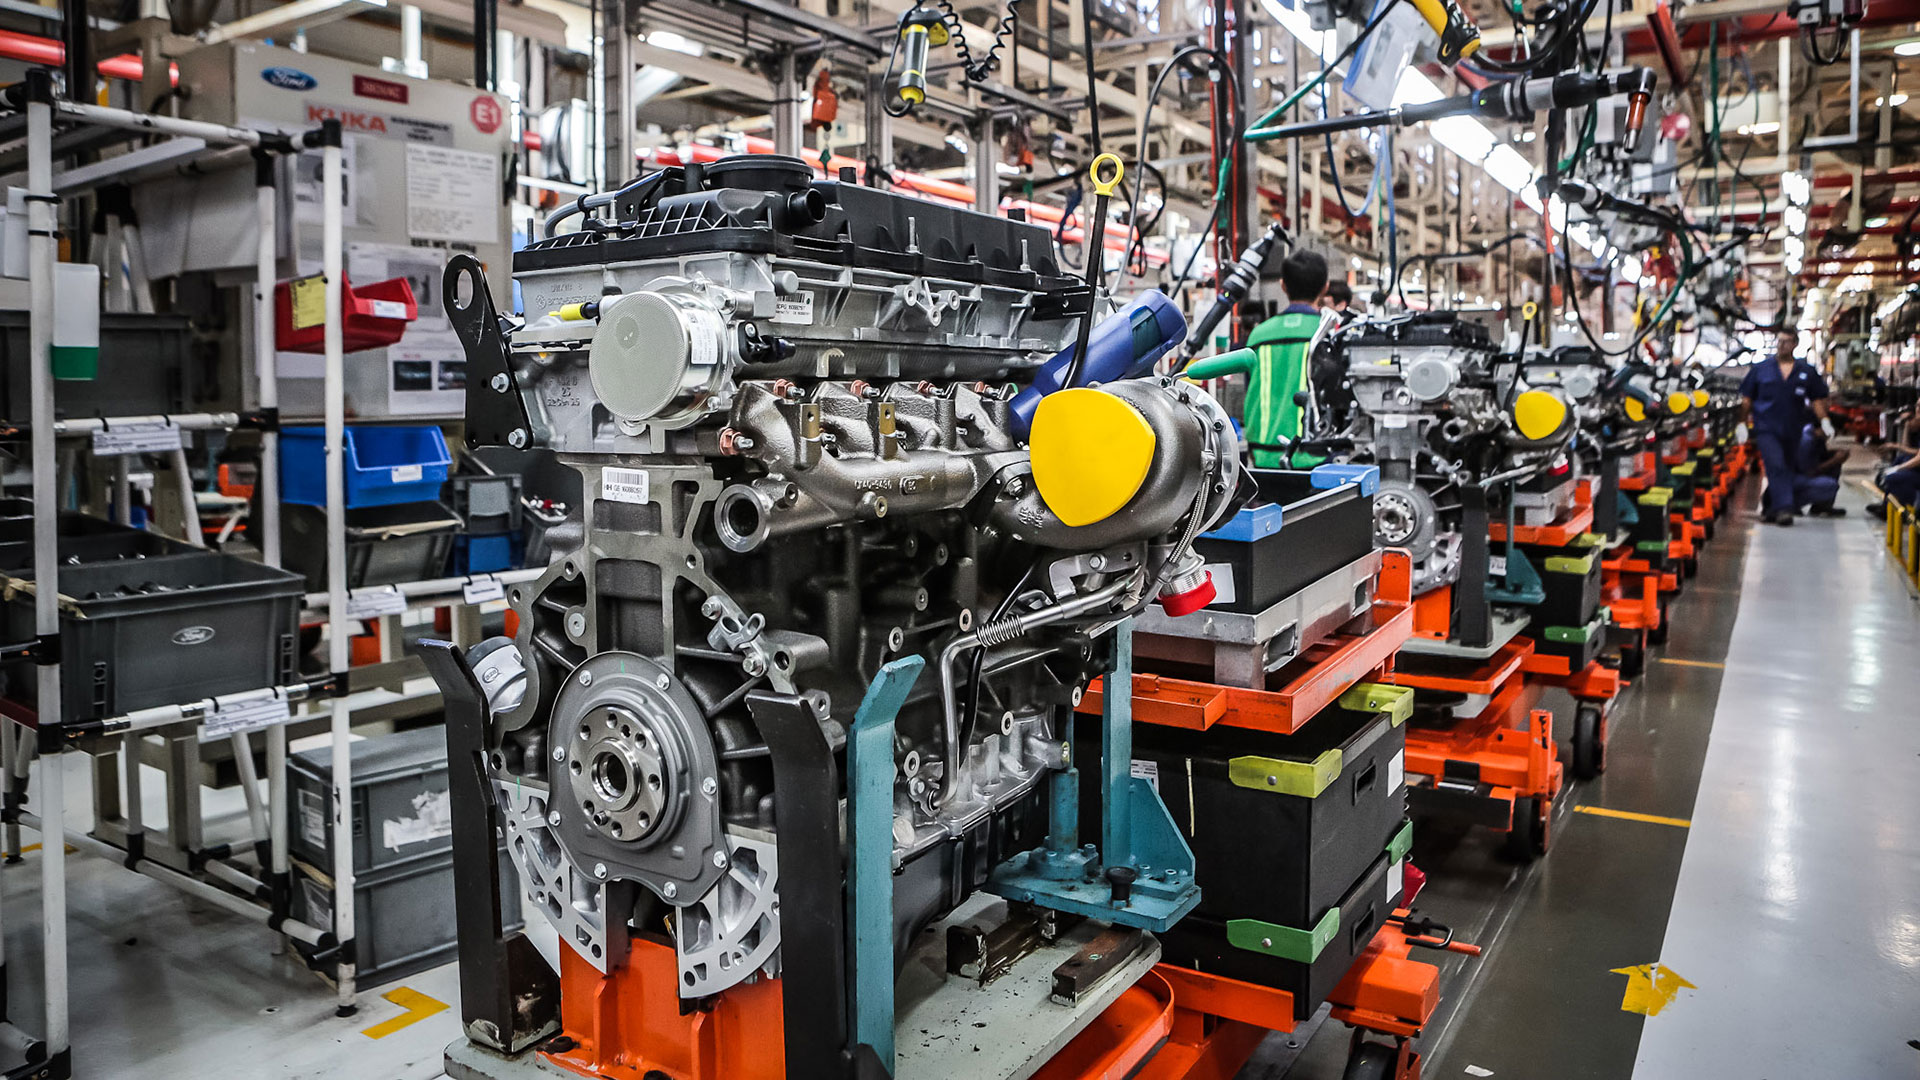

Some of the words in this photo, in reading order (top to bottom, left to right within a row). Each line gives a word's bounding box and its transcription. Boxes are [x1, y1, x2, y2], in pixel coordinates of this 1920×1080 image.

[268, 69, 309, 89] Ford
[307, 104, 387, 133] KUKA
[476, 103, 499, 126] E1
[178, 628, 209, 643] Ford
